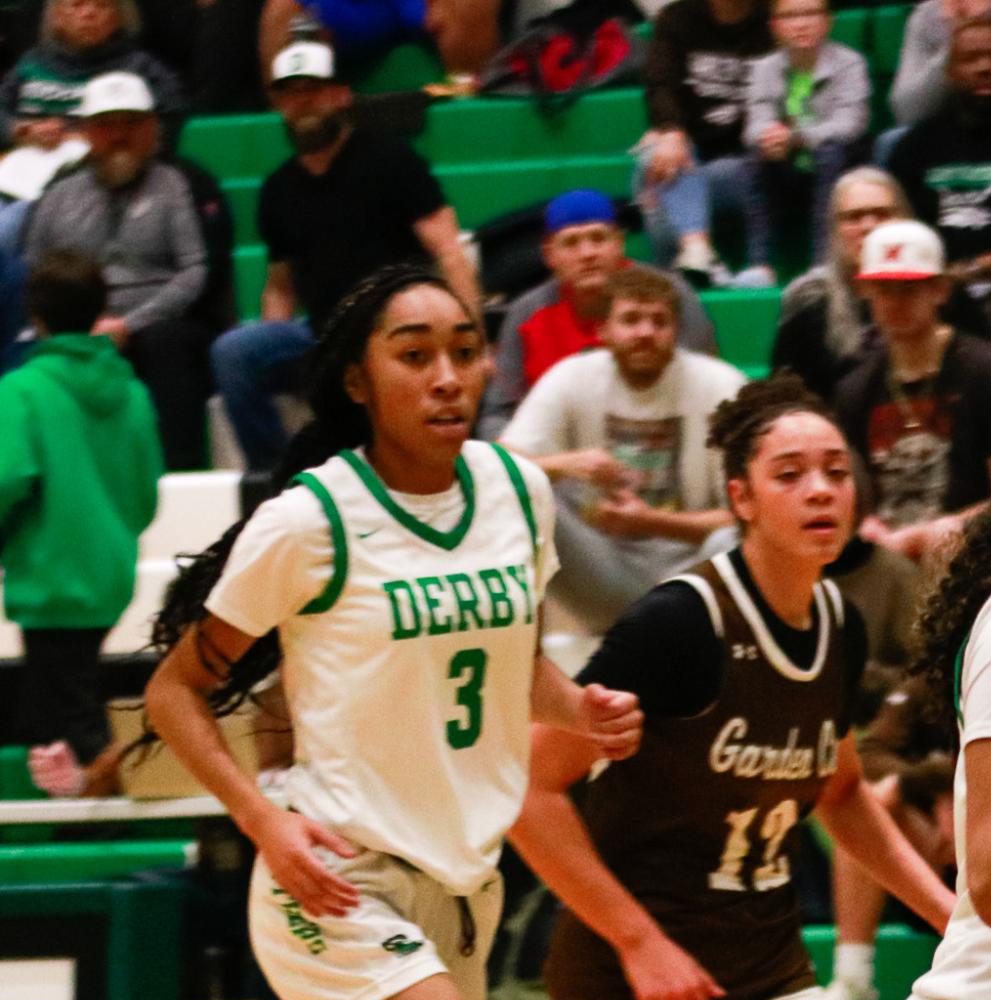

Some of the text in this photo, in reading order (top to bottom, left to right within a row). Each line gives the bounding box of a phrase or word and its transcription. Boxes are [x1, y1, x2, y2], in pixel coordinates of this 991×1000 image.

[383, 564, 534, 641] DERBY
[446, 648, 488, 751] 3
[710, 717, 814, 780] Garden
